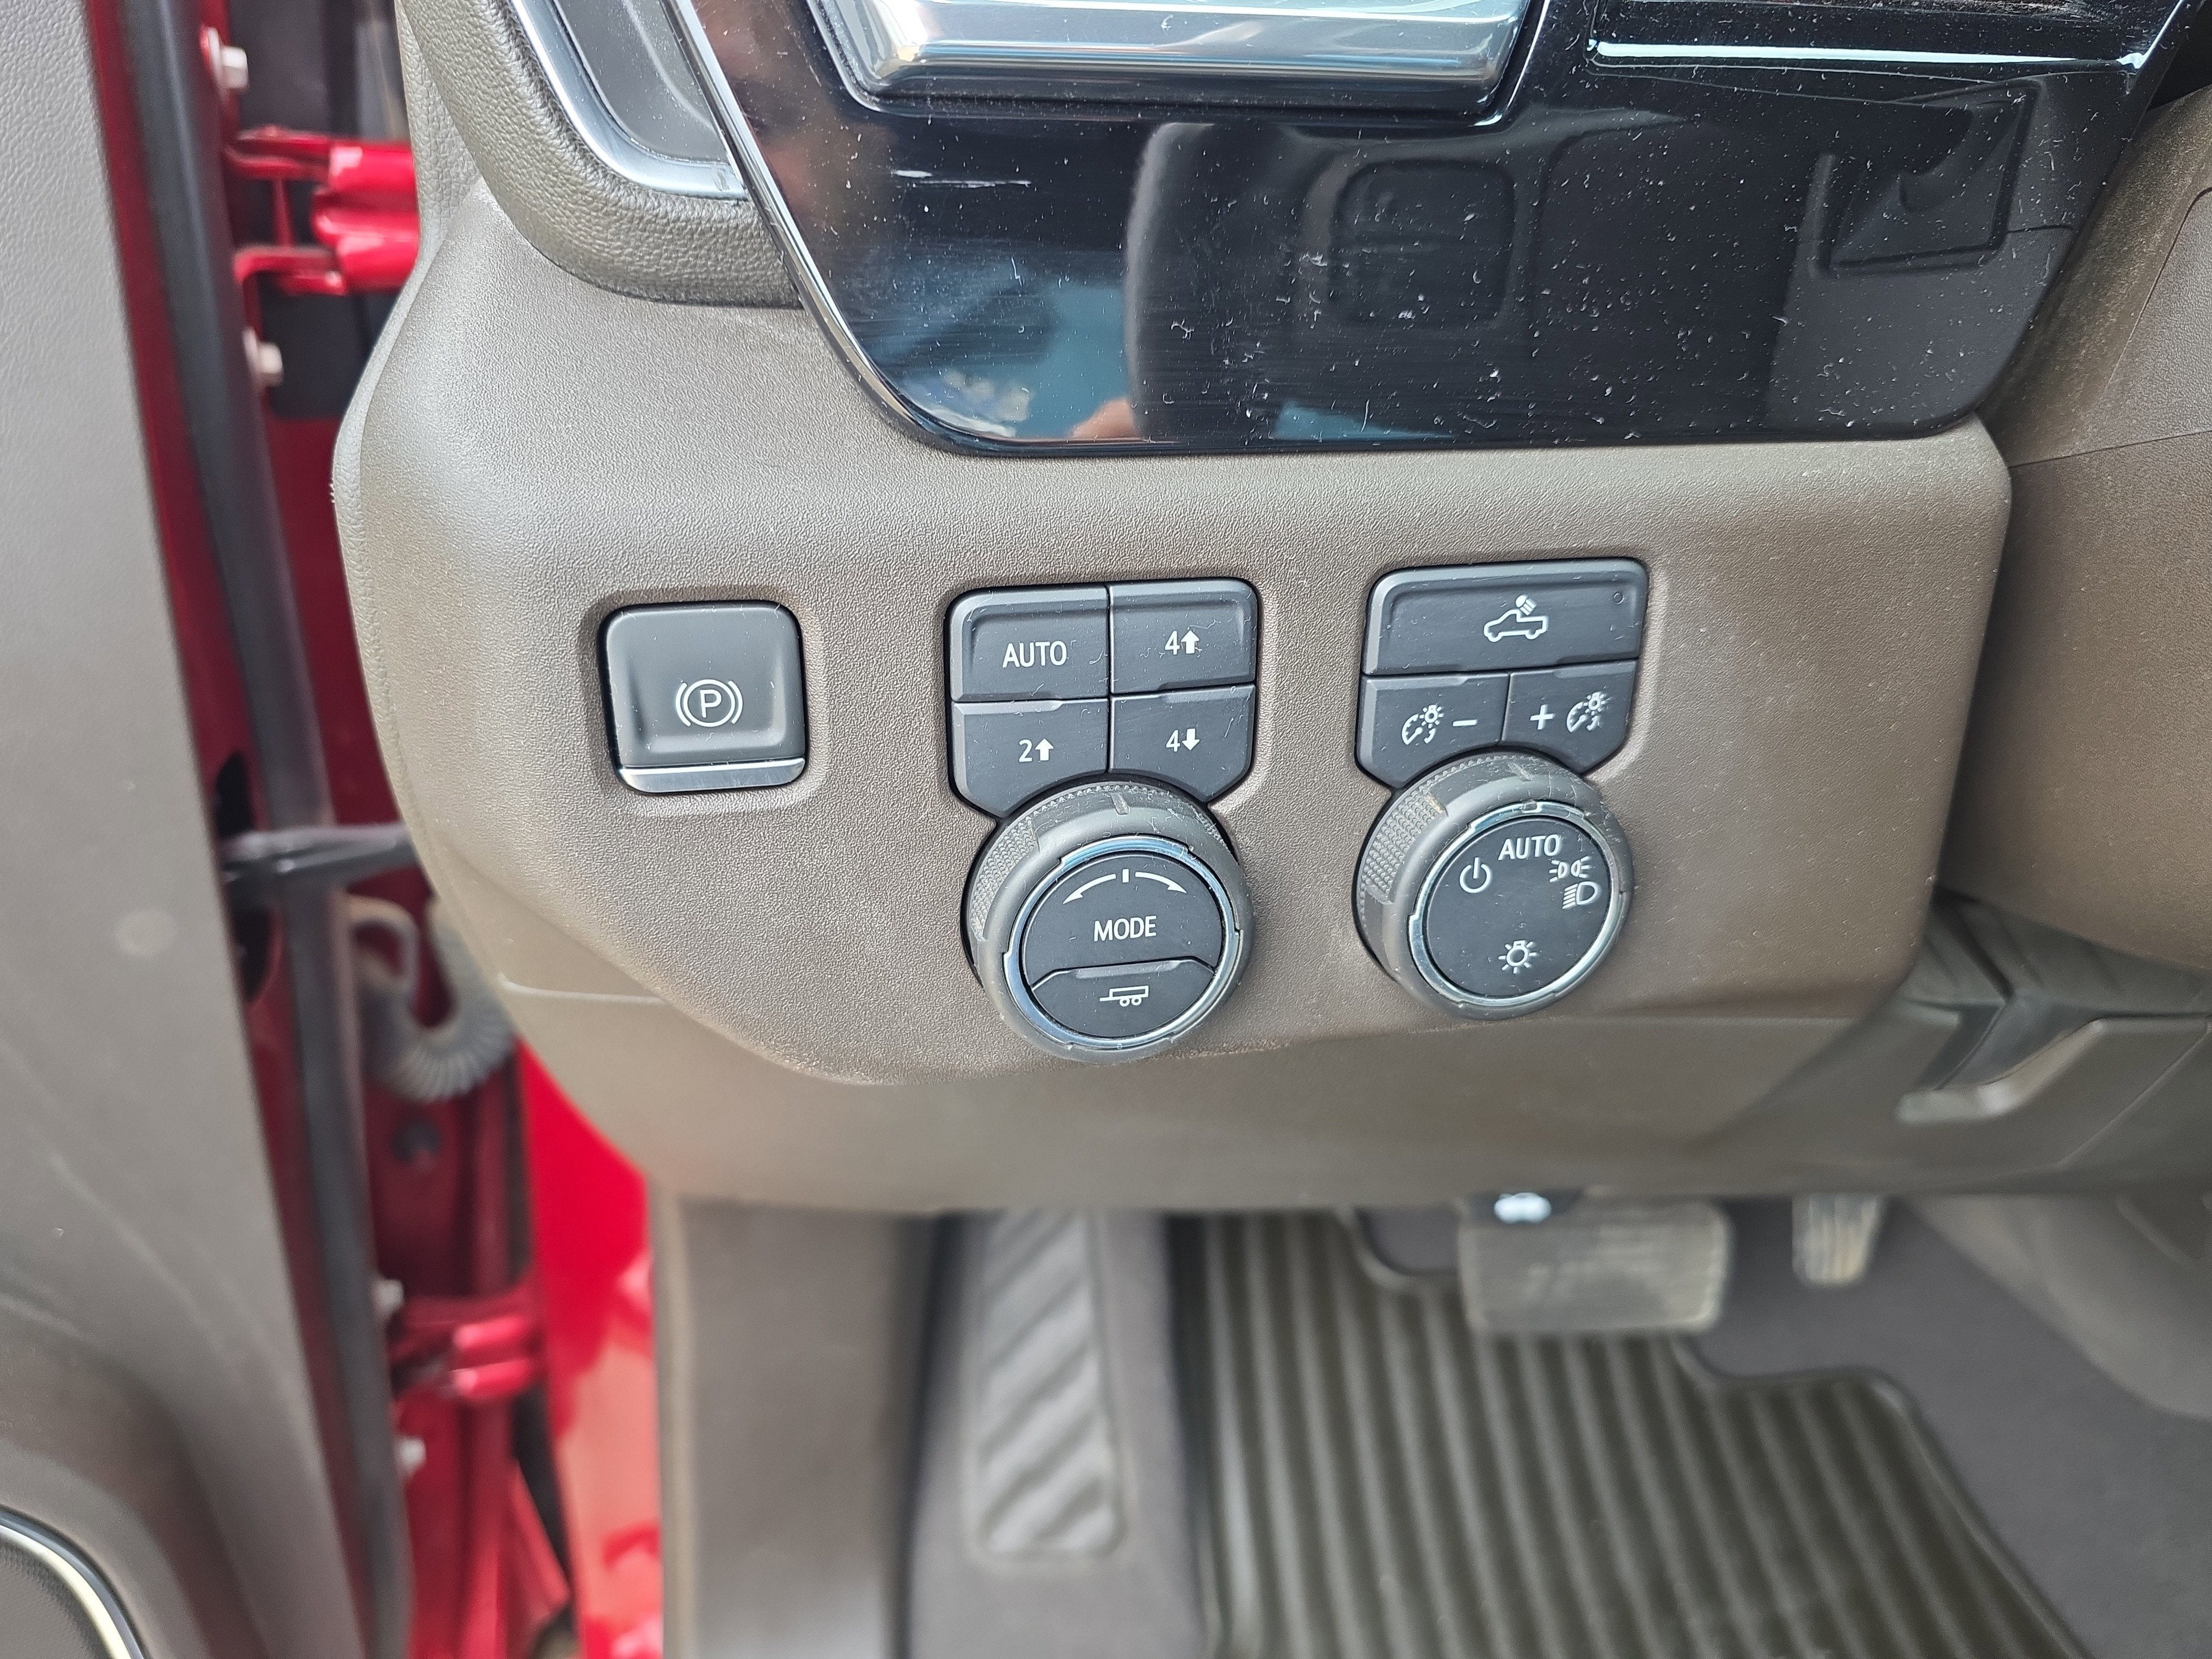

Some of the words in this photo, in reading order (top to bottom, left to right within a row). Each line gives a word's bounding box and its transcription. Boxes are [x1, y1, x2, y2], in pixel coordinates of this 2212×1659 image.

[1002, 640, 1068, 668] AUTO
[699, 689, 722, 718] P
[1497, 834, 1561, 860] AUTO
[1094, 915, 1157, 942] MODE
